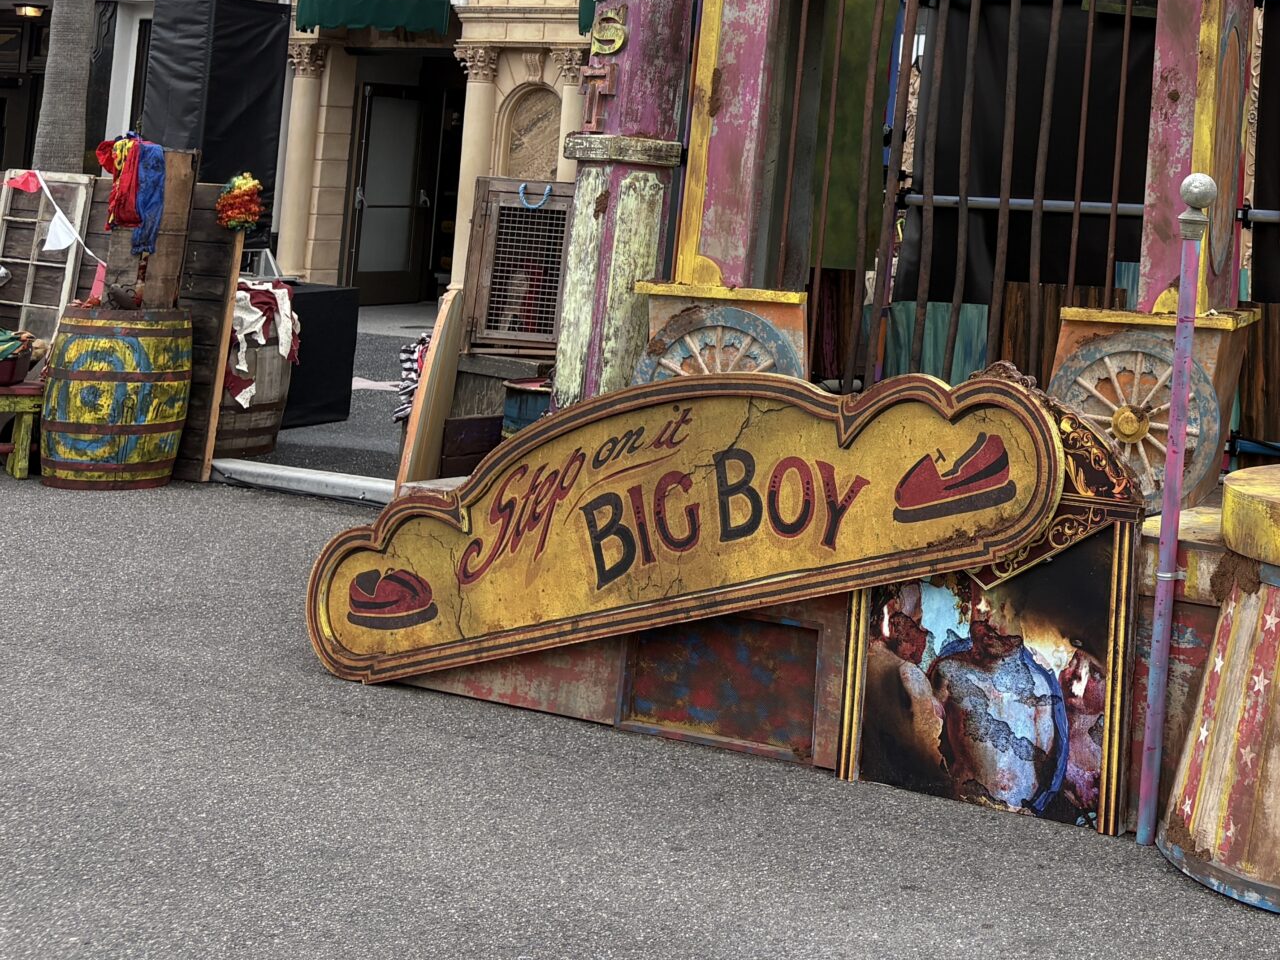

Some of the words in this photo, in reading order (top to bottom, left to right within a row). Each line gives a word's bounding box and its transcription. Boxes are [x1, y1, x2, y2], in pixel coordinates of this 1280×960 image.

[458, 445, 586, 587] Step
[592, 424, 646, 471] on
[644, 405, 696, 451] it
[578, 470, 700, 591] BIG
[712, 447, 871, 551] BOY
